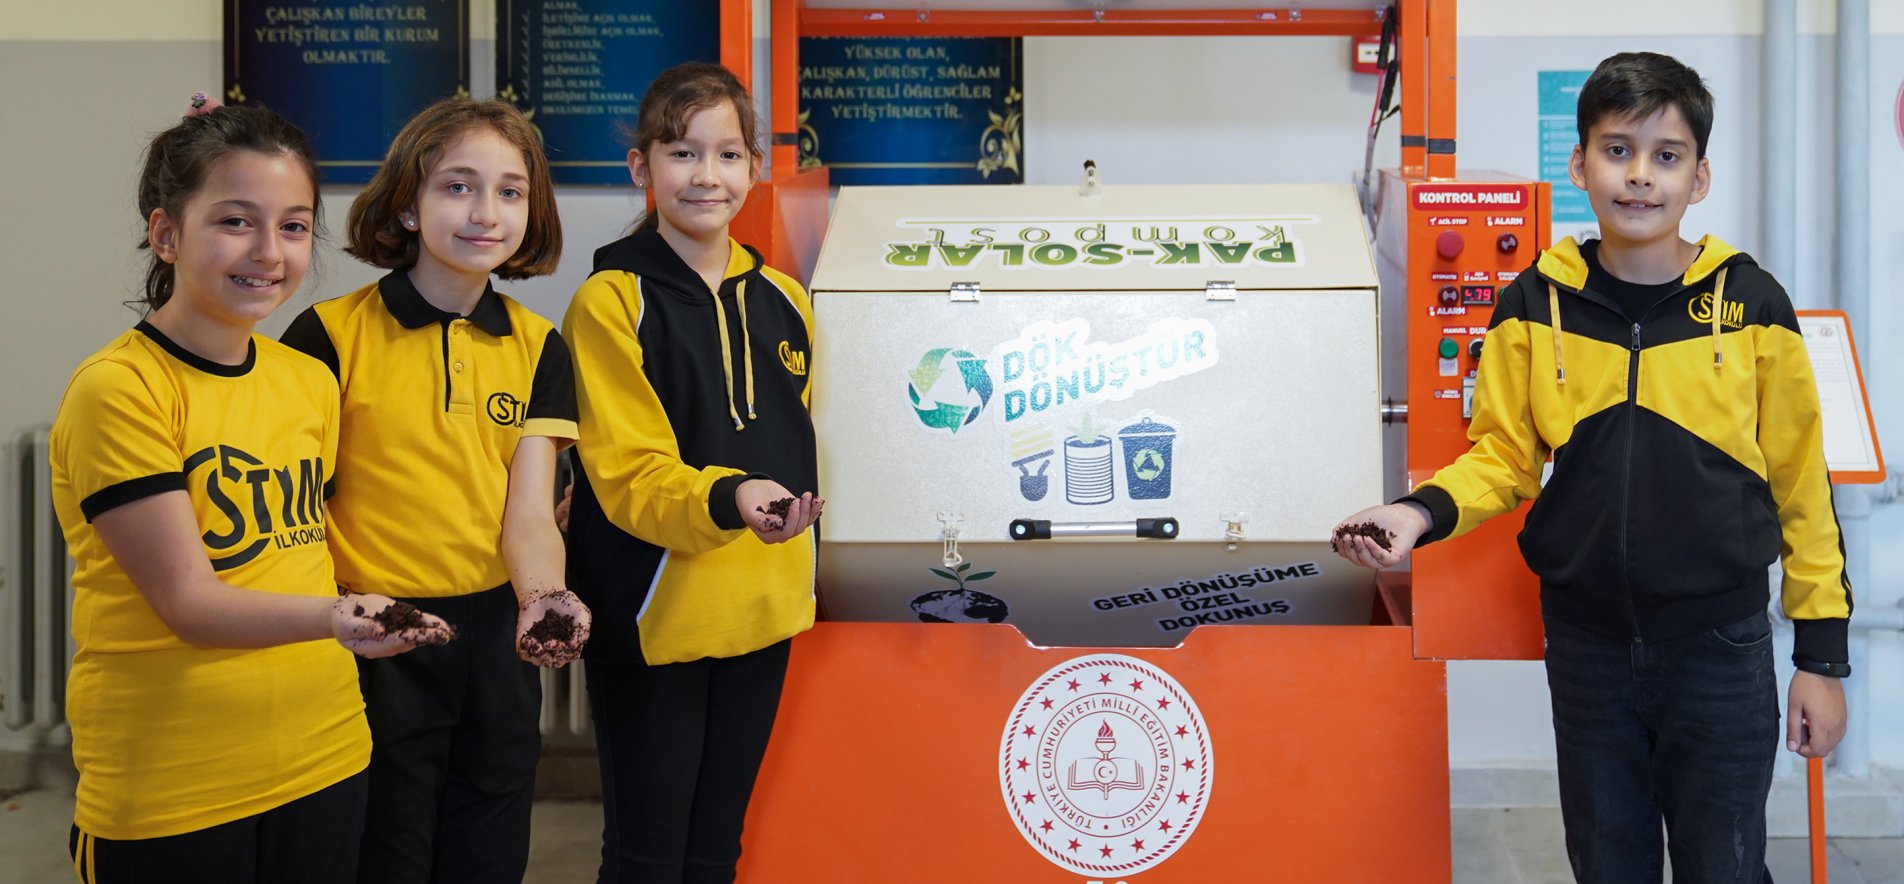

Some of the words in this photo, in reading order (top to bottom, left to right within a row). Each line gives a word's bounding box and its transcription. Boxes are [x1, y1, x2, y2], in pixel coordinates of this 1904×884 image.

[265, 6, 344, 25] ÇALIŞKAN
[349, 3, 427, 21] BİREYLER
[255, 24, 350, 47] YETİŞTİREN
[354, 24, 380, 42] BİR
[385, 28, 439, 42] KURUM
[302, 49, 391, 64] OLMAKTIR.
[844, 44, 901, 60] YÜKSEK
[906, 46, 950, 62] OLAN,
[937, 63, 1000, 79] SAĞLAM
[802, 83, 900, 99] KARAKTERLİ
[903, 82, 992, 99] ÖĞRENCİLER
[832, 102, 962, 123] YETİŞTİRMEKTİR.
[1418, 192, 1476, 204] KONTROL
[1477, 190, 1520, 204] PANELİ
[1494, 217, 1523, 225] ALARM
[927, 223, 1286, 247] kompost
[887, 241, 1298, 267] PAK-SOLAR
[1437, 307, 1466, 315] ALARM
[1003, 331, 1078, 383] DÖK
[1094, 588, 1158, 611] GERİ
[1160, 563, 1318, 600] DÖNÜŞÜME
[1180, 592, 1250, 612] ÖZEL
[1159, 600, 1290, 631] DOKUNUŞ
[1101, 698, 1139, 716] MİLLİ
[1042, 697, 1096, 779] CUMHURİYETİ
[1139, 713, 1169, 759] EĞİTİM
[1046, 783, 1093, 830] TÜRKİYE
[1122, 765, 1169, 829] BAKANLIĞI
